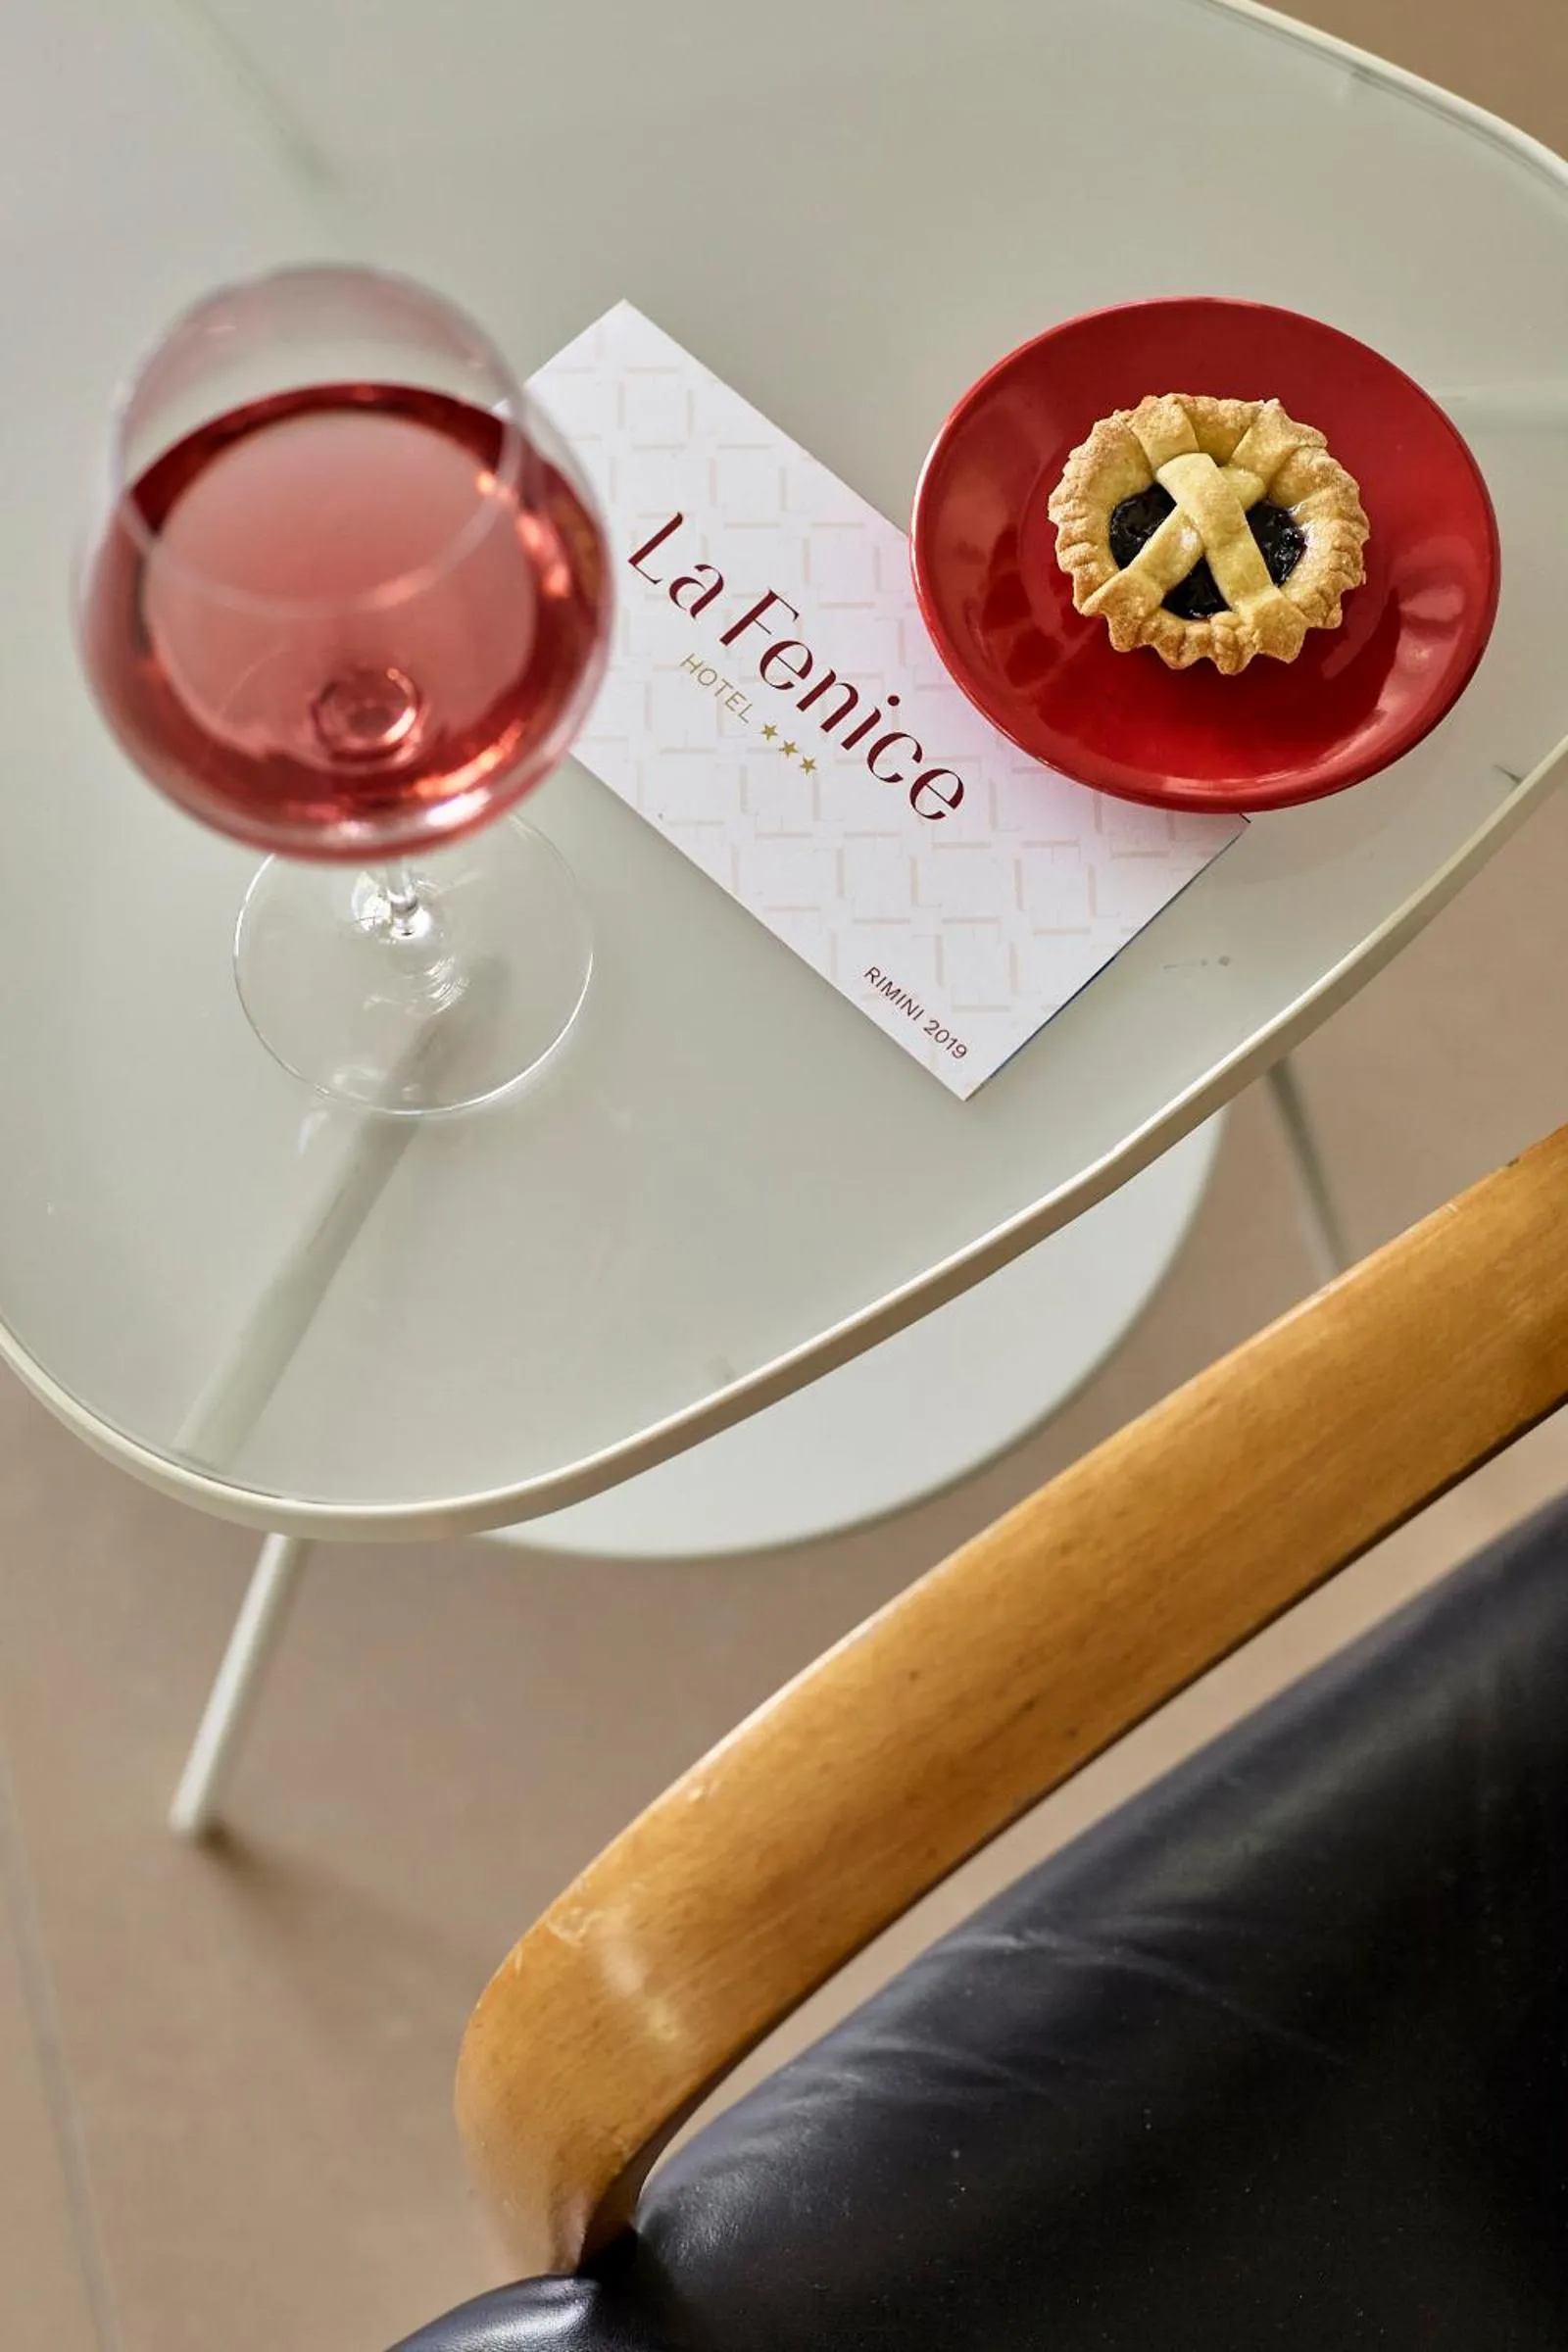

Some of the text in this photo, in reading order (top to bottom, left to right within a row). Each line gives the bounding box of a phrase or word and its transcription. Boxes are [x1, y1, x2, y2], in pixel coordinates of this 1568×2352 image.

[627, 512, 965, 821] La Fenice
[680, 653, 754, 724] HOTEL
[863, 966, 967, 1059] RIMINI 2019
